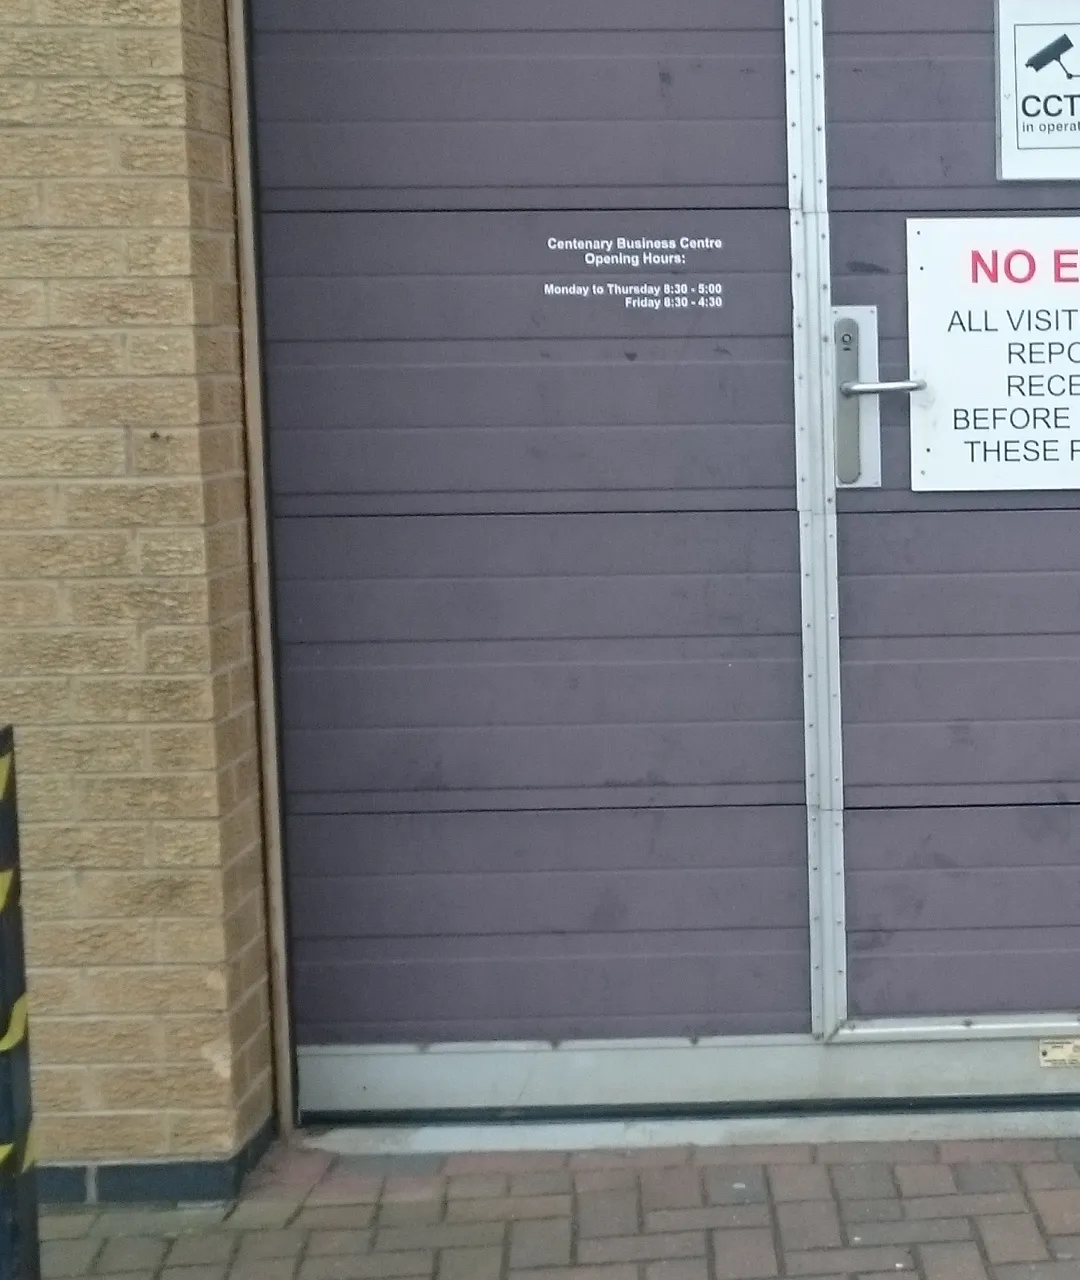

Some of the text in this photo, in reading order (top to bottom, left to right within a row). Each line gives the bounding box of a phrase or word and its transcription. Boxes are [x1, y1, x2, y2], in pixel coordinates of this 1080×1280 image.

[1022, 121, 1034, 132] in
[547, 237, 722, 251] Centenary Business Centre
[585, 253, 686, 266] Opening Hours:
[970, 249, 1036, 284] NO
[544, 284, 589, 296] Monday
[592, 284, 604, 295] to
[607, 283, 661, 296] Thursday
[663, 284, 687, 294] 8:30
[698, 284, 722, 294] 5:00
[625, 297, 661, 309] Friday
[663, 297, 688, 307] 8:30
[698, 297, 722, 307] 4:30
[947, 309, 998, 332] ALL
[953, 406, 1071, 430] BEFORE
[964, 439, 1060, 463] THESE
